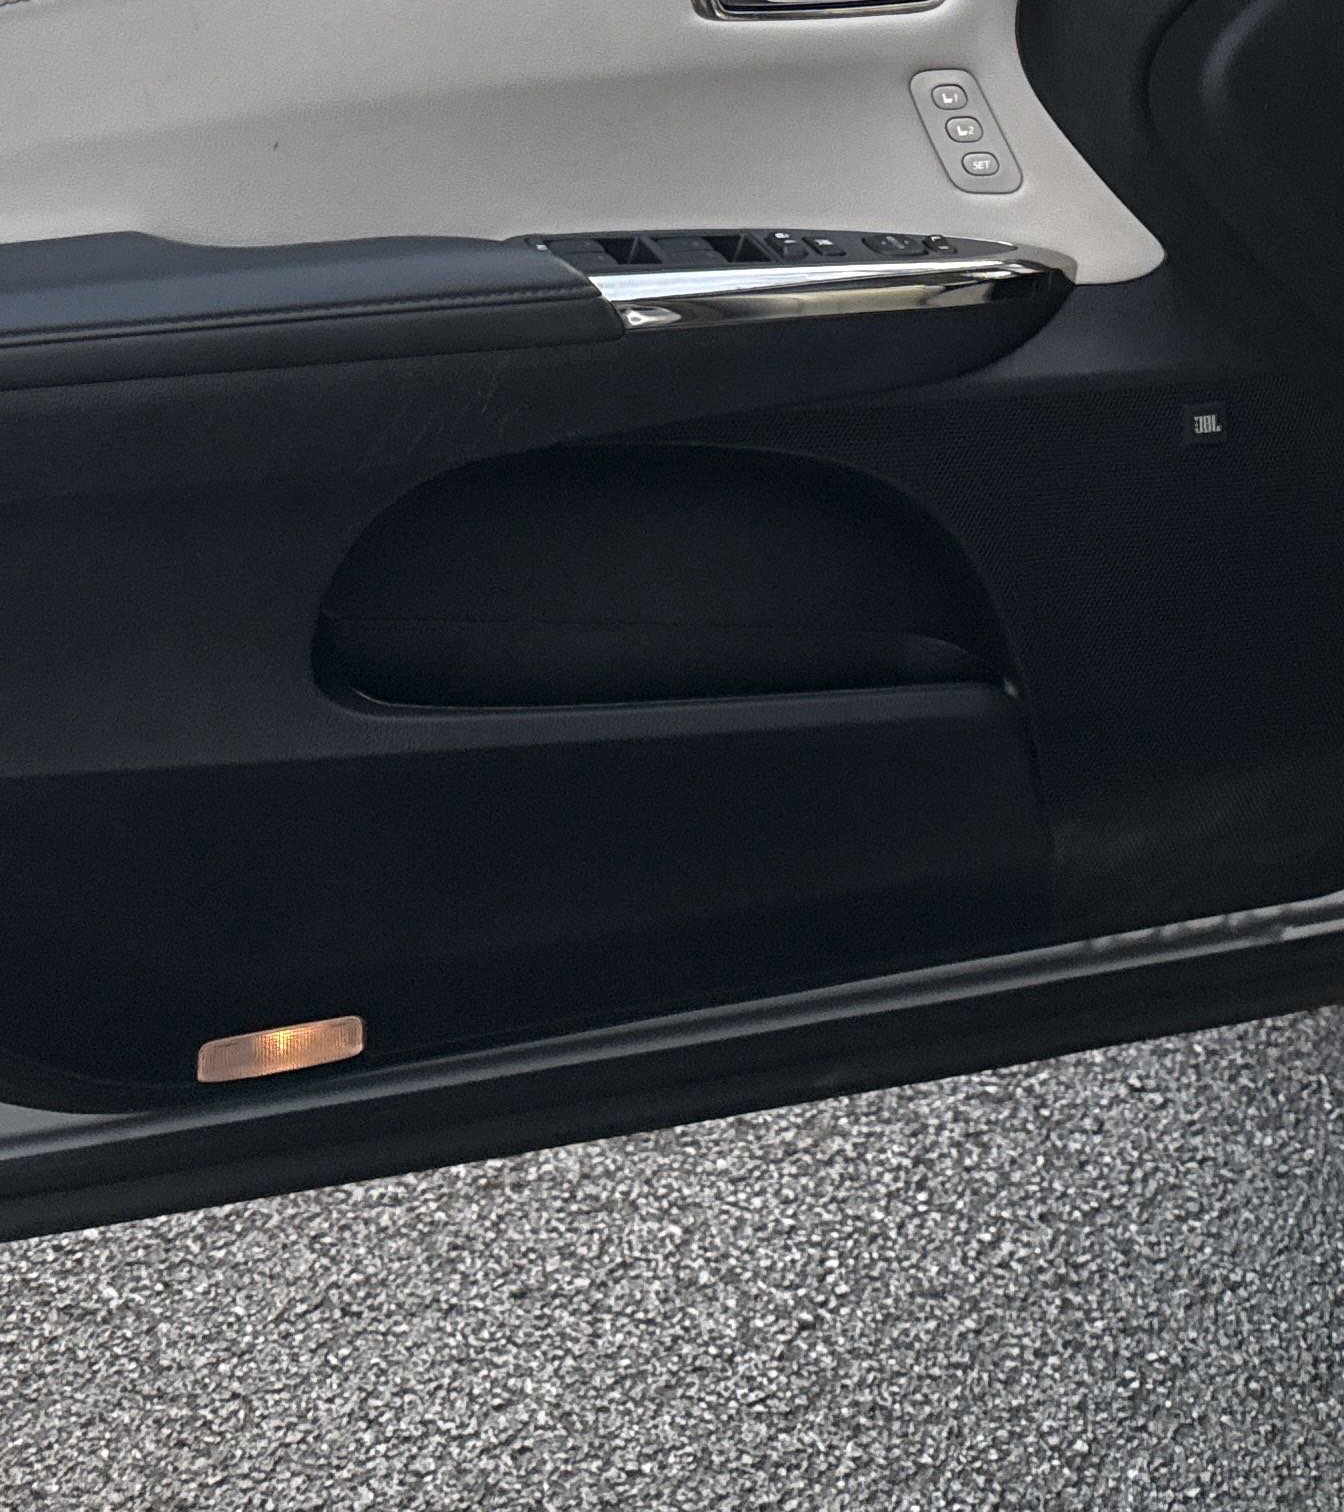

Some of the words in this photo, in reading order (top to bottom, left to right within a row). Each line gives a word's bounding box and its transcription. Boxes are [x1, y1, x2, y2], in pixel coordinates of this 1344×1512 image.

[967, 125, 974, 135] 2
[972, 159, 990, 170] SET
[1193, 414, 1223, 434] JBL
